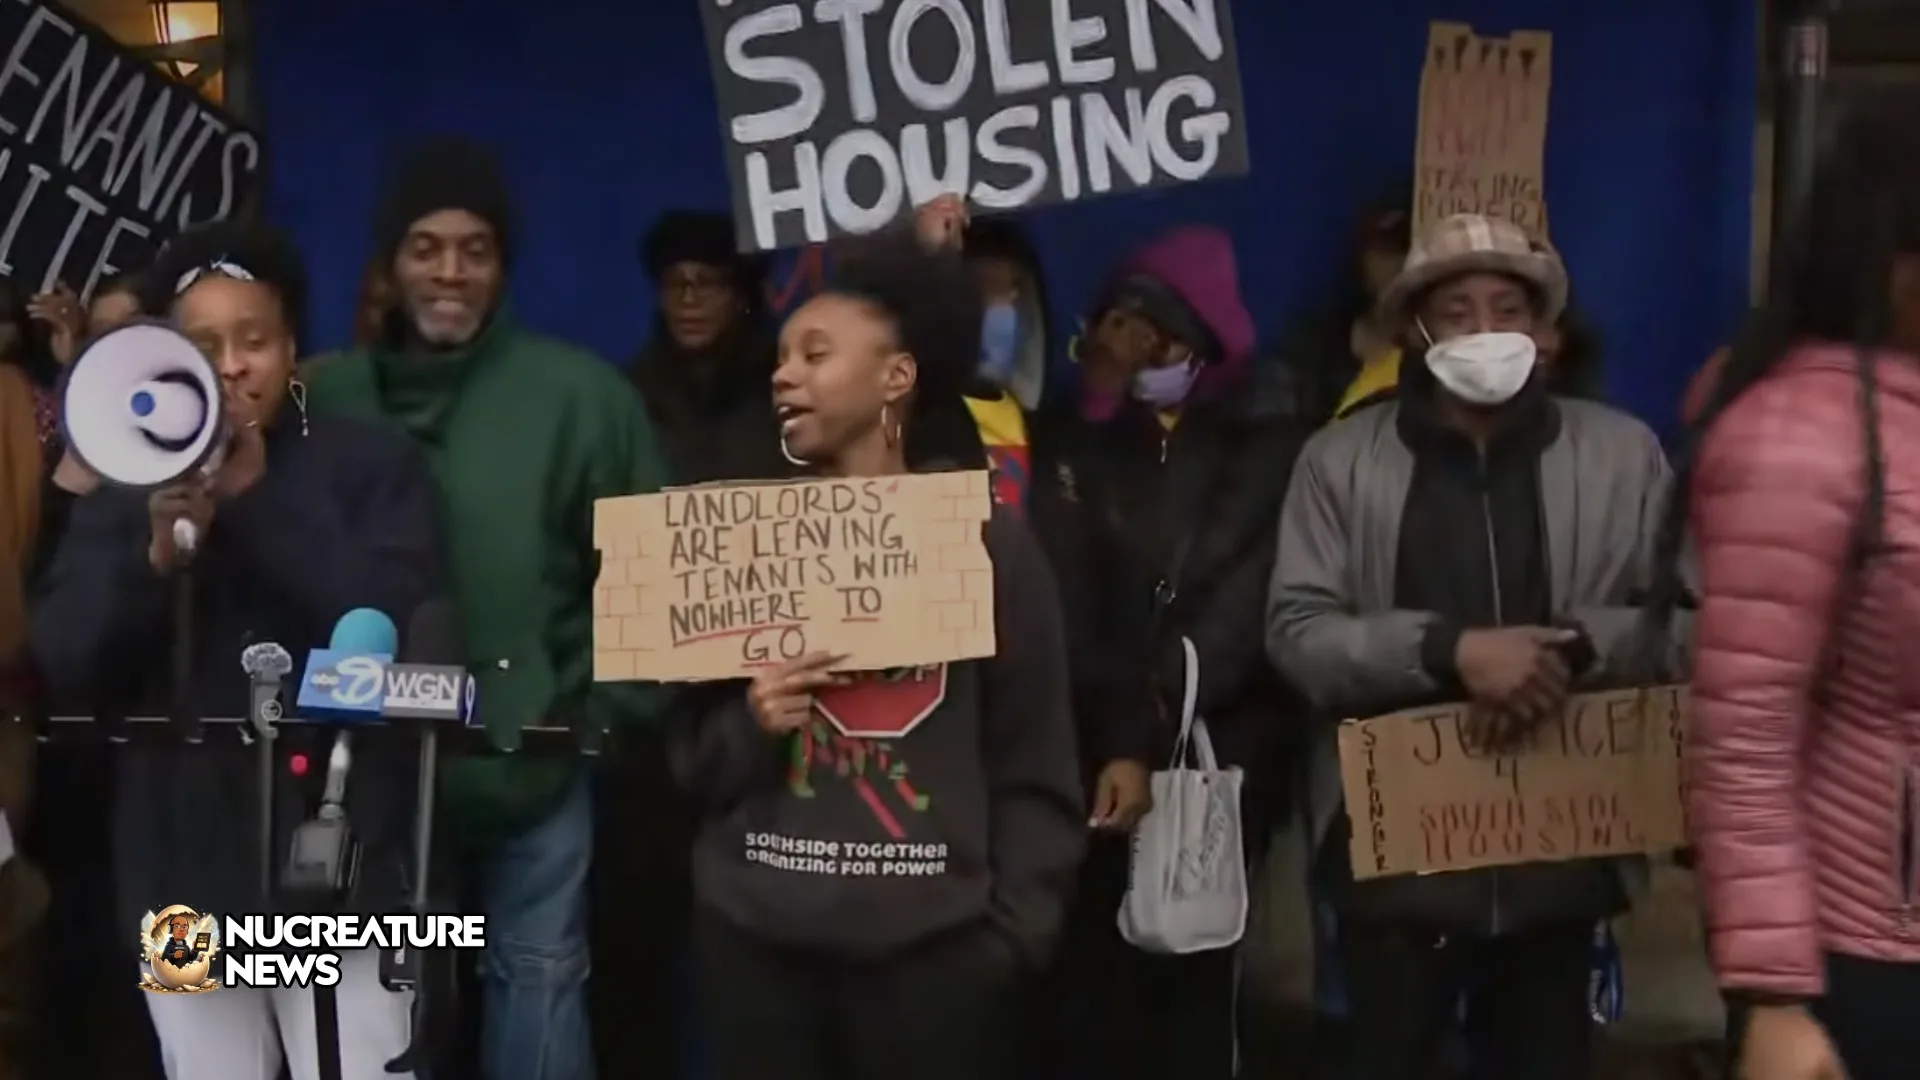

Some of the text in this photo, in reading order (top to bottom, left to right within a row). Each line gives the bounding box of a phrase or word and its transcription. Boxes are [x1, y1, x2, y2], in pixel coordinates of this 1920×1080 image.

[724, 0, 1222, 142] STOLEN
[0, 5, 258, 232] ENANTS
[745, 74, 1230, 250] HOUSING
[670, 513, 903, 568] ARE LEAVING
[675, 551, 918, 601] TENANTS WITH
[669, 586, 882, 640] NOWHERE TO
[742, 625, 806, 662] GO
[331, 656, 385, 705] 7
[386, 671, 460, 700] WGN
[1411, 698, 1640, 766] JUICE
[1496, 757, 1519, 796] 4
[841, 861, 876, 875] FOR
[882, 861, 946, 876] POWER
